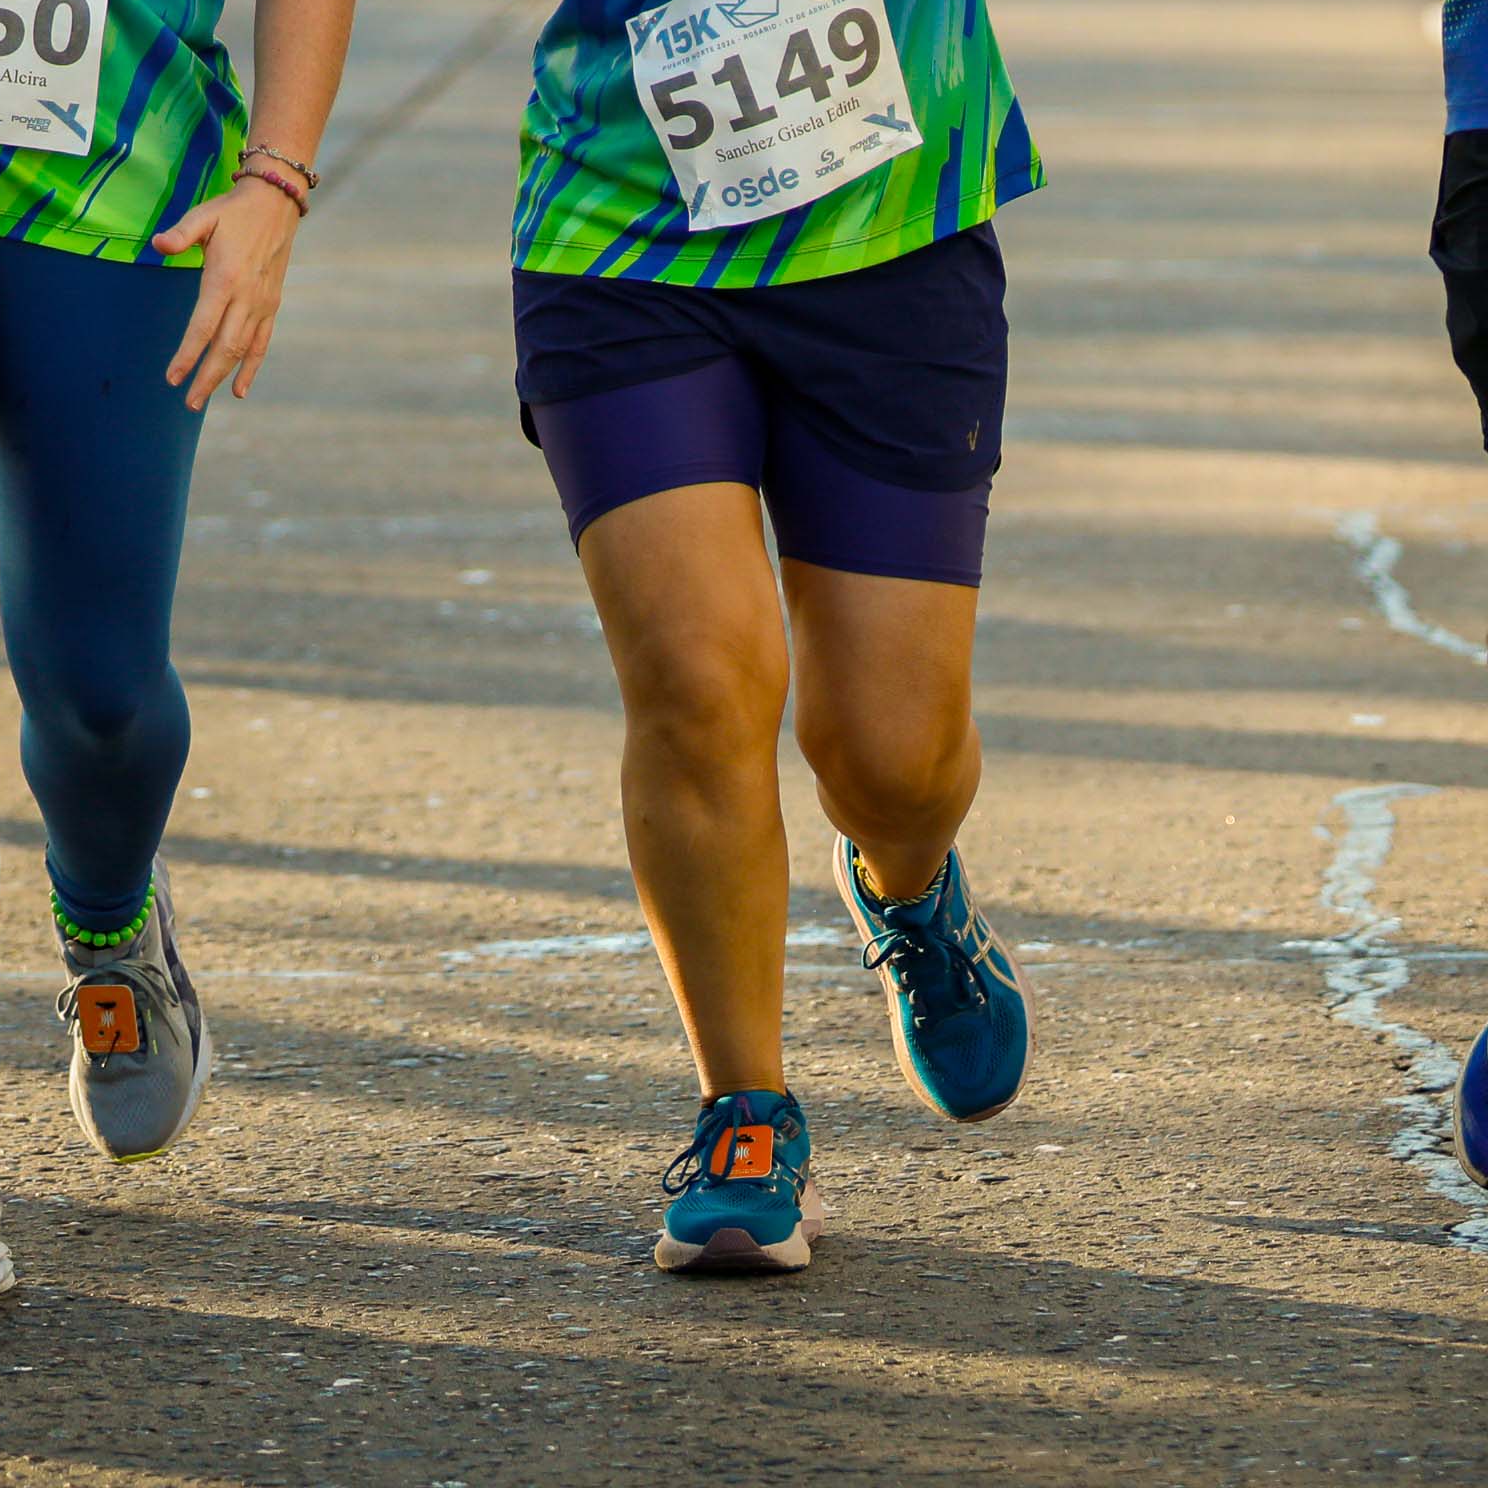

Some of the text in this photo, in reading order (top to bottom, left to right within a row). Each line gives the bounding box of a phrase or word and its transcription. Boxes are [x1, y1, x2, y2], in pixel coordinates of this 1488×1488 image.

[655, 7, 720, 60] 15K
[0, 68, 48, 87] Alcira
[650, 8, 880, 151] 5149
[715, 97, 860, 164] Sanchez Gisela Edith
[722, 166, 800, 208] osde
